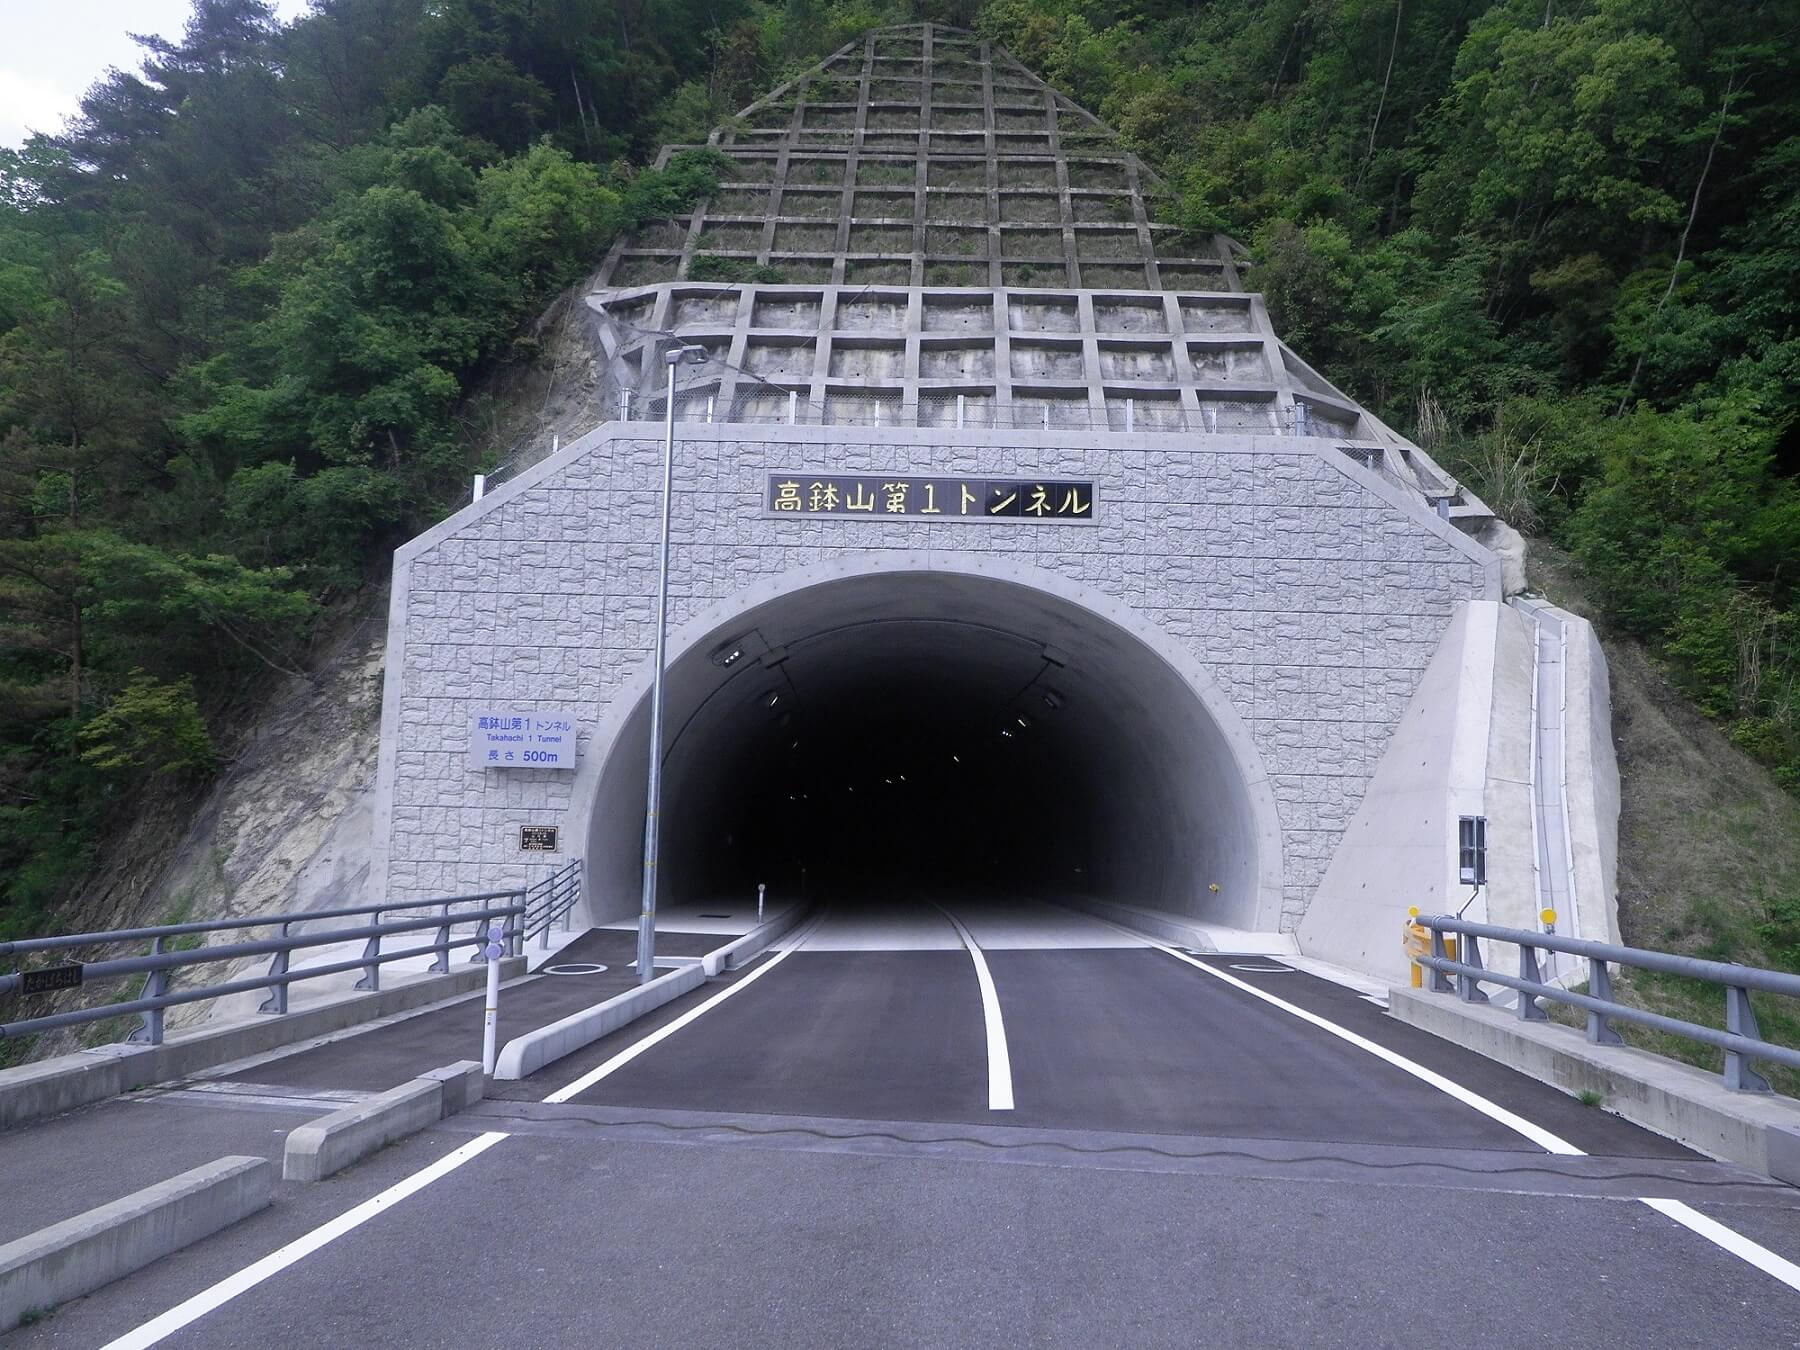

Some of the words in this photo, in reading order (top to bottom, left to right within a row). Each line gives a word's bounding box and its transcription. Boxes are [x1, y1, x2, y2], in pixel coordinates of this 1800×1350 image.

[773, 479, 1091, 517] 高鉢山第1トンネル
[487, 734, 524, 743] Takahachi
[528, 734, 532, 742] 1
[538, 734, 562, 743] Tunnel
[488, 749, 515, 761] 長さ
[523, 750, 558, 763] 500m
